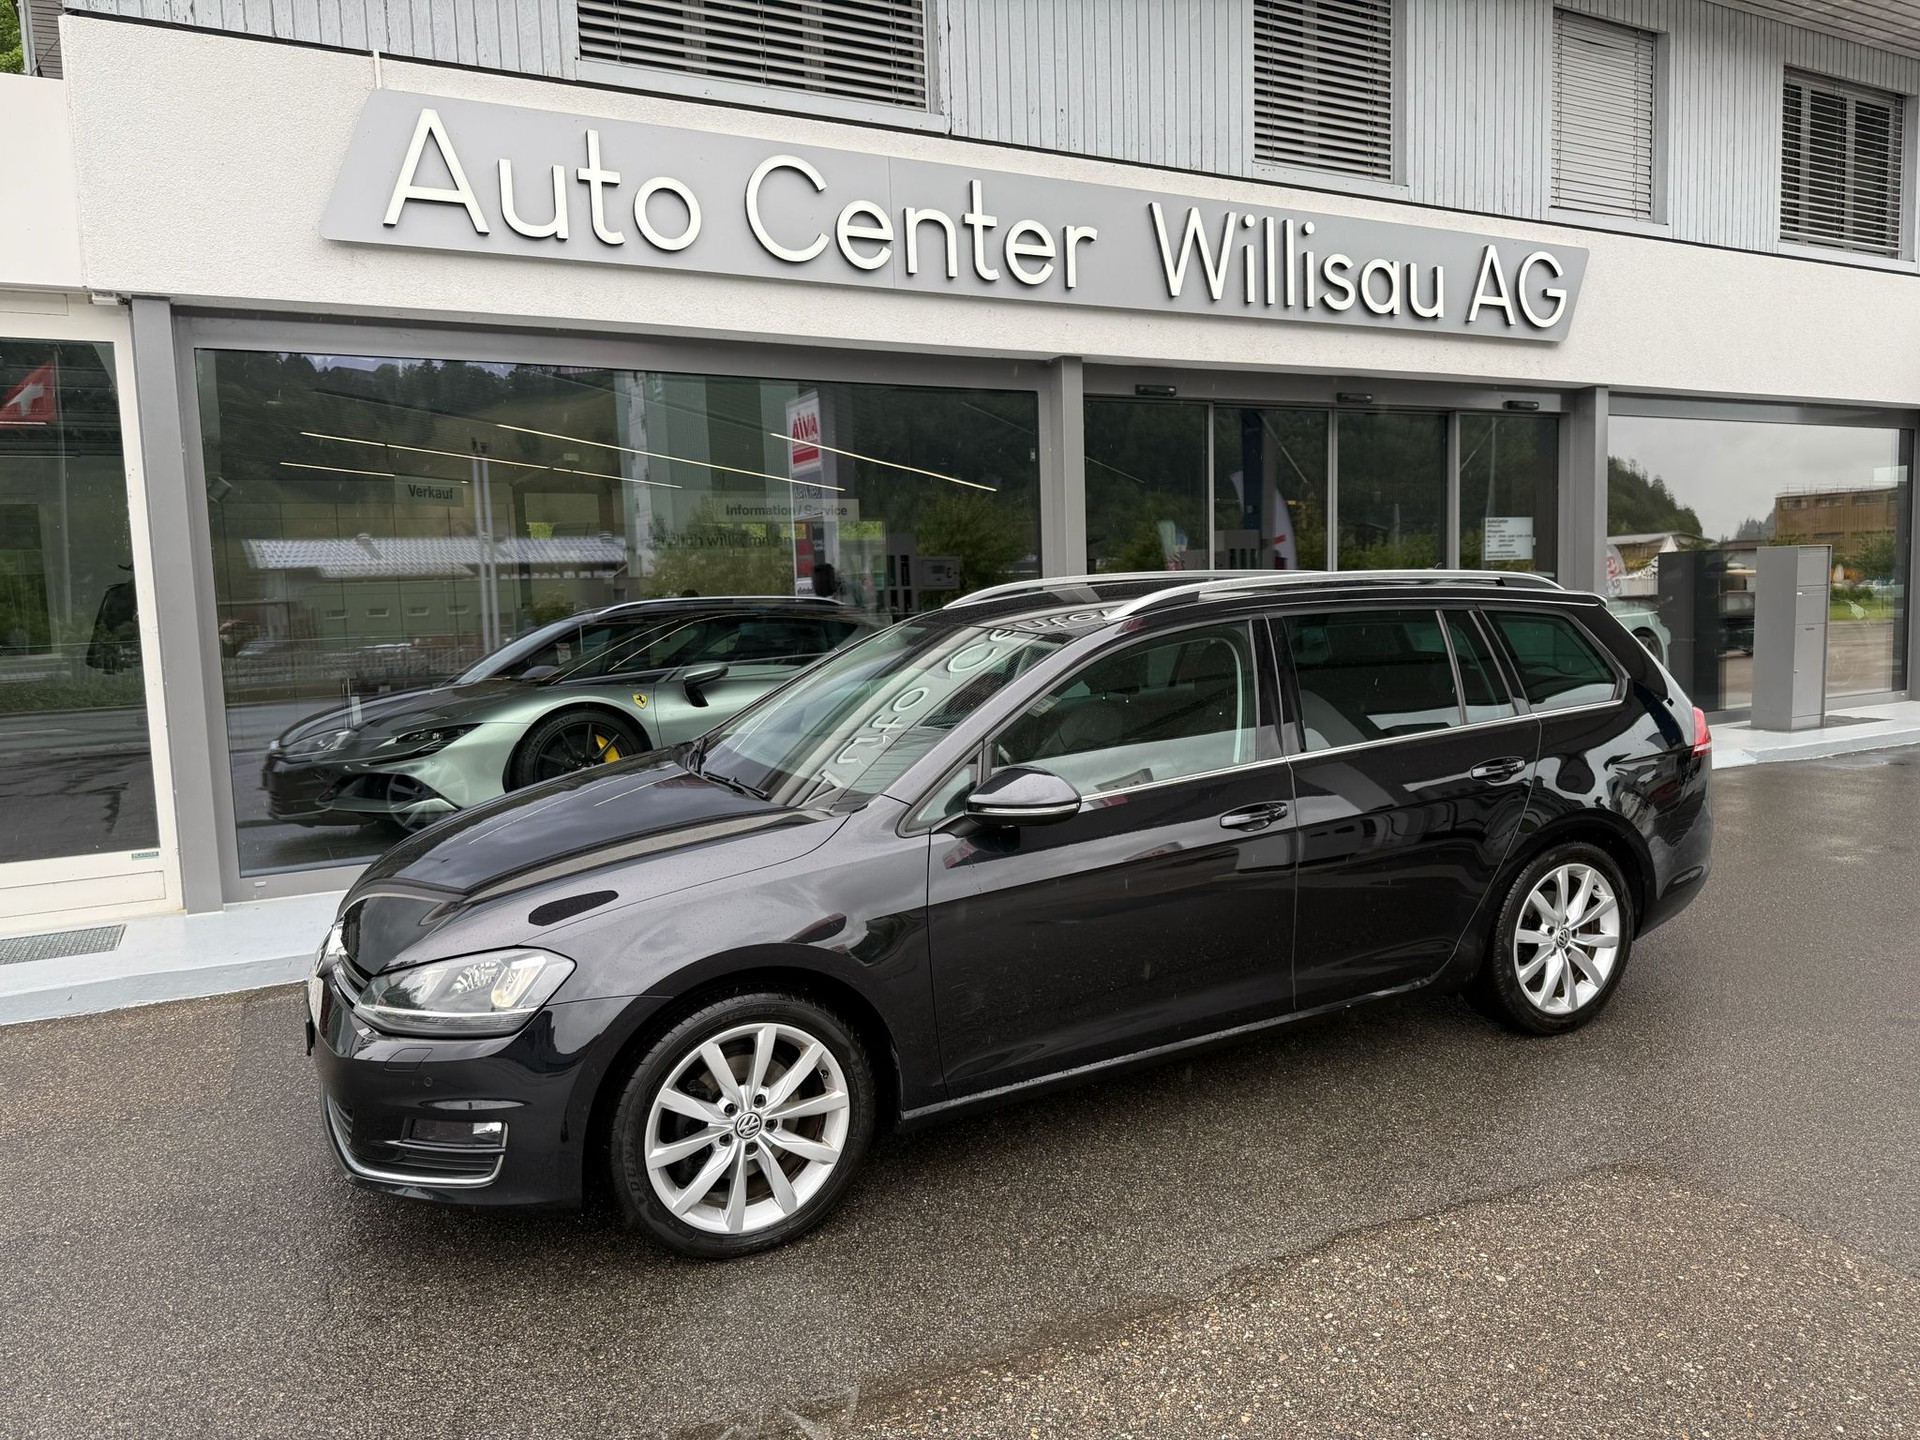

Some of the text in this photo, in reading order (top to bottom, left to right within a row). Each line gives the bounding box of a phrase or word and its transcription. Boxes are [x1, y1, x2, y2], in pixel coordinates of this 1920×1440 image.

[382, 108, 1568, 329] Auto Center Willisau AG
[408, 484, 454, 500] Verkauf
[726, 503, 794, 518] Information
[804, 504, 848, 516] Service
